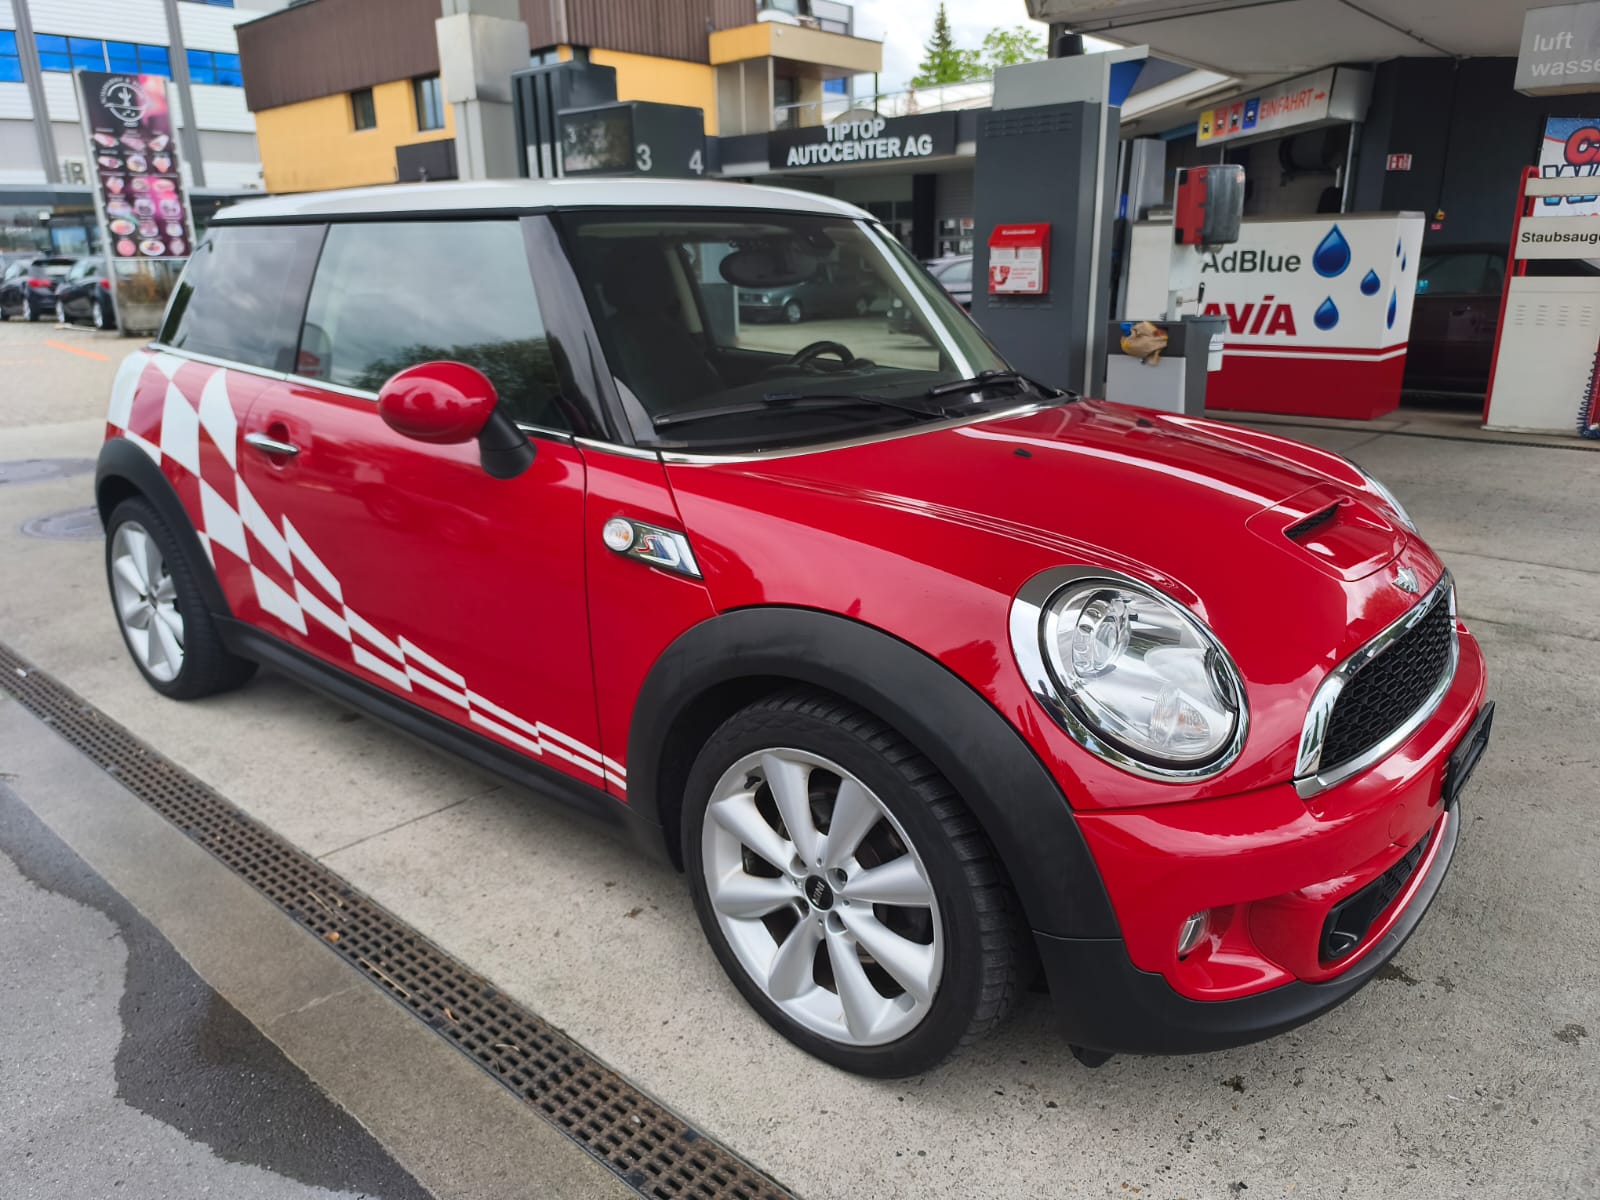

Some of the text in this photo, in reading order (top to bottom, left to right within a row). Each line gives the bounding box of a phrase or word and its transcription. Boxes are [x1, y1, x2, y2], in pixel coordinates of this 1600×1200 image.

[1533, 31, 1574, 52] luft
[1260, 87, 1314, 120] EINFAHRT
[824, 118, 886, 142] TIPTOP
[636, 143, 652, 172] 3
[688, 149, 704, 175] 4
[786, 134, 933, 167] AUTOCENTER AG
[1521, 231, 1600, 245] Staubsaug
[1201, 250, 1302, 274] AdBlue
